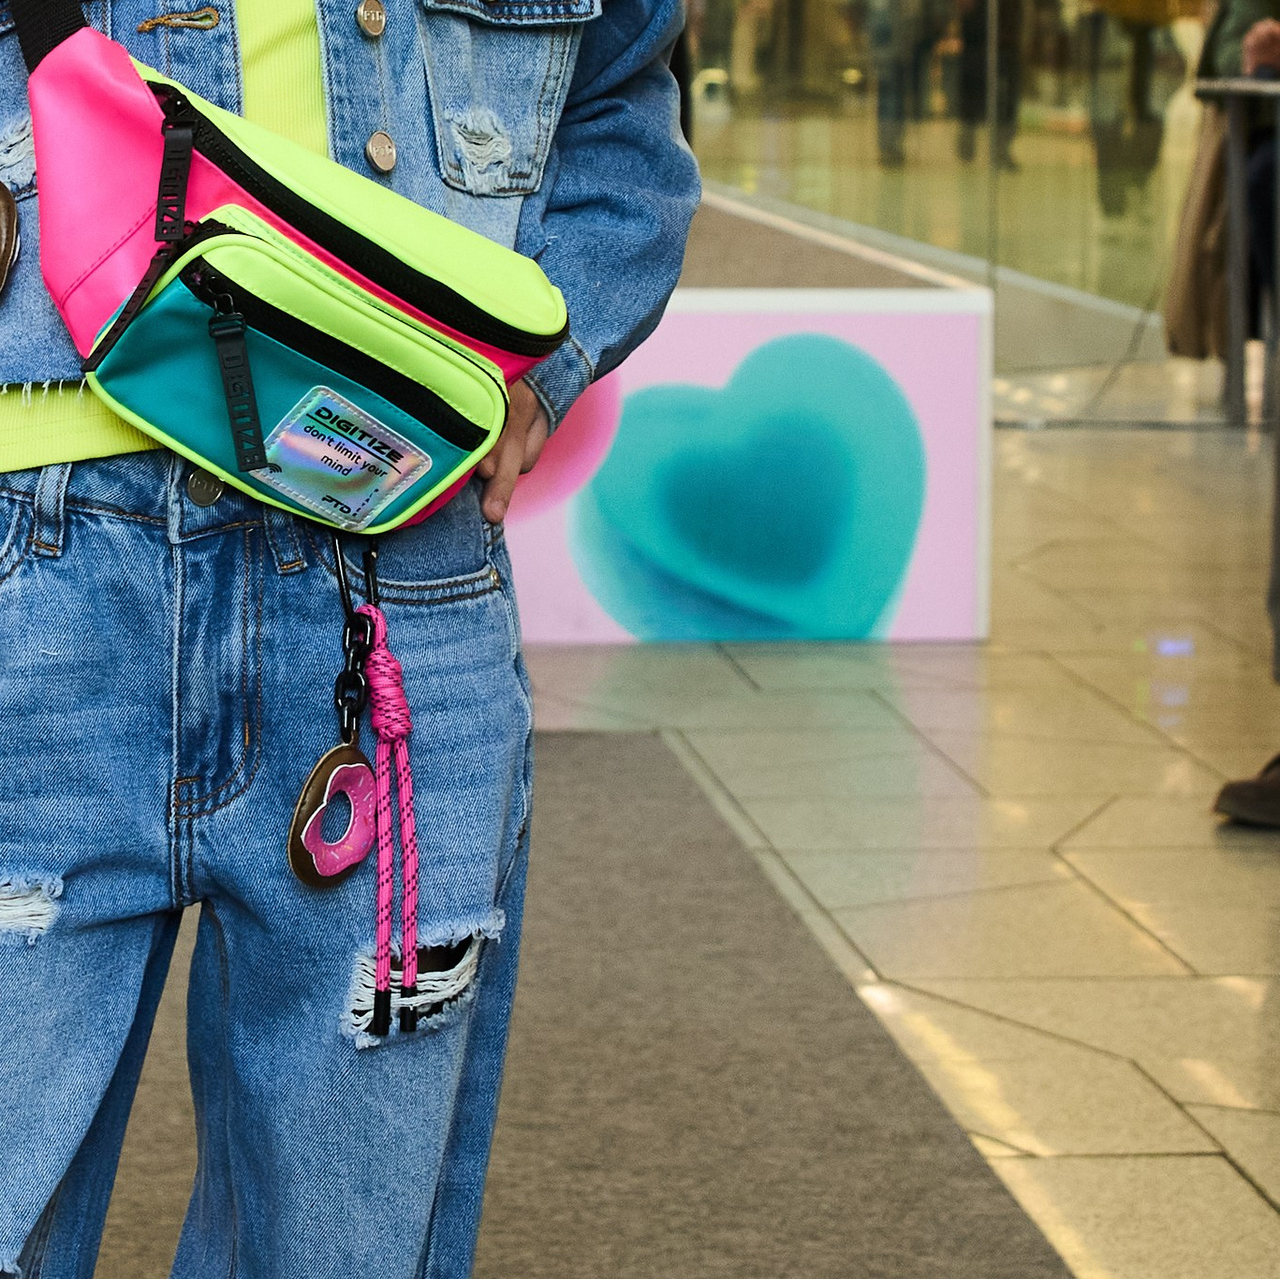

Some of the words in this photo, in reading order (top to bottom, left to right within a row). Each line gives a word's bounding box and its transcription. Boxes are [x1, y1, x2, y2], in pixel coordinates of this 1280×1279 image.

[304, 424, 336, 447] don't
[334, 441, 362, 465] limit
[360, 460, 388, 478] your
[314, 406, 405, 464] DIGITIZE
[321, 455, 353, 477] mind
[322, 495, 351, 514] PTD
